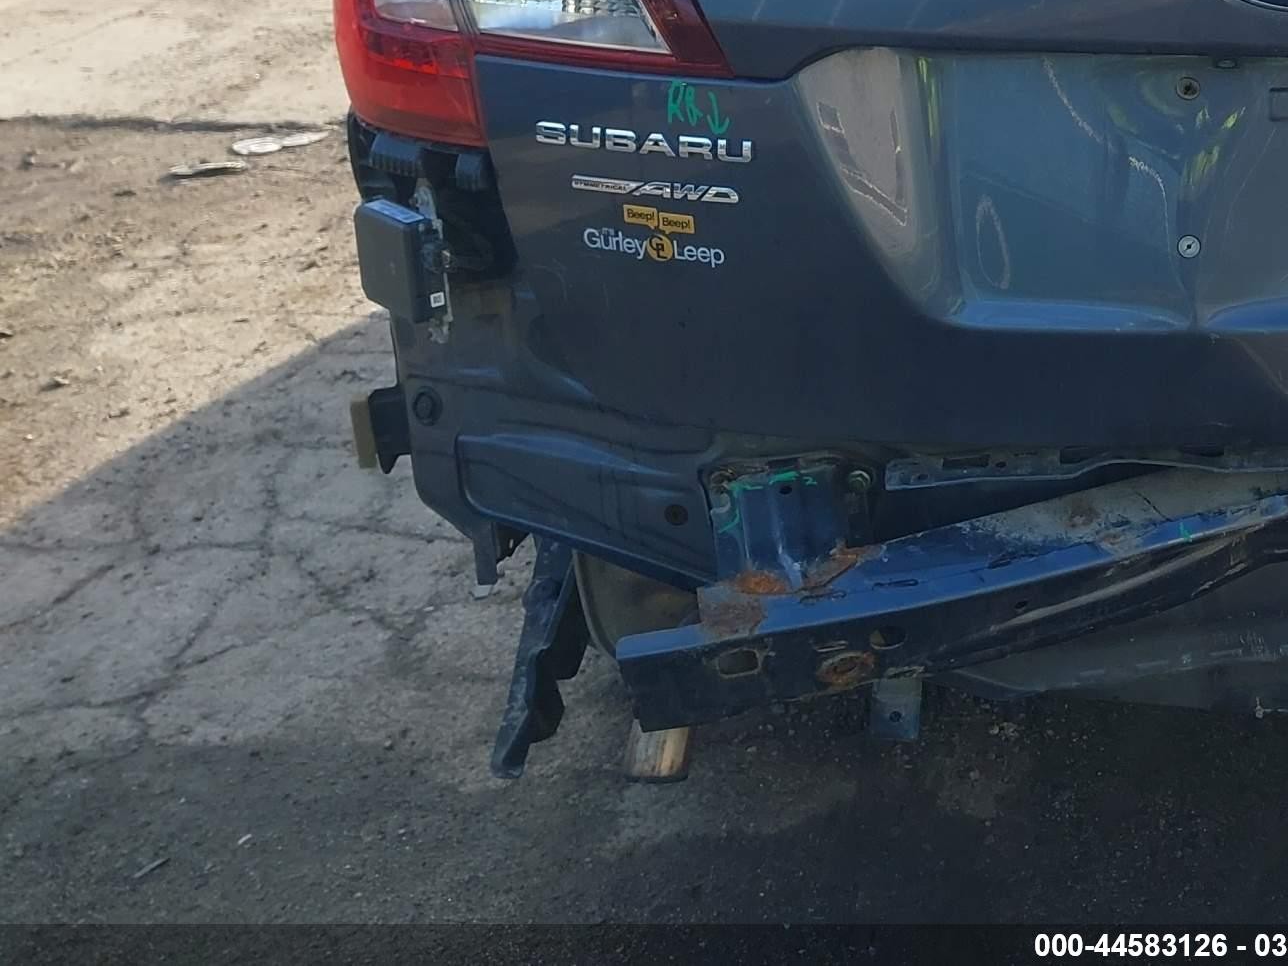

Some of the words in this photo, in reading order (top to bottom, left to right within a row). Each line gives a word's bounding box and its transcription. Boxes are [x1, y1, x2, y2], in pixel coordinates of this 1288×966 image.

[535, 121, 752, 163] SUBARU
[632, 182, 740, 203] AWD
[626, 208, 656, 223] Beep!
[662, 216, 691, 230] Beep!
[673, 240, 726, 268] Leep
